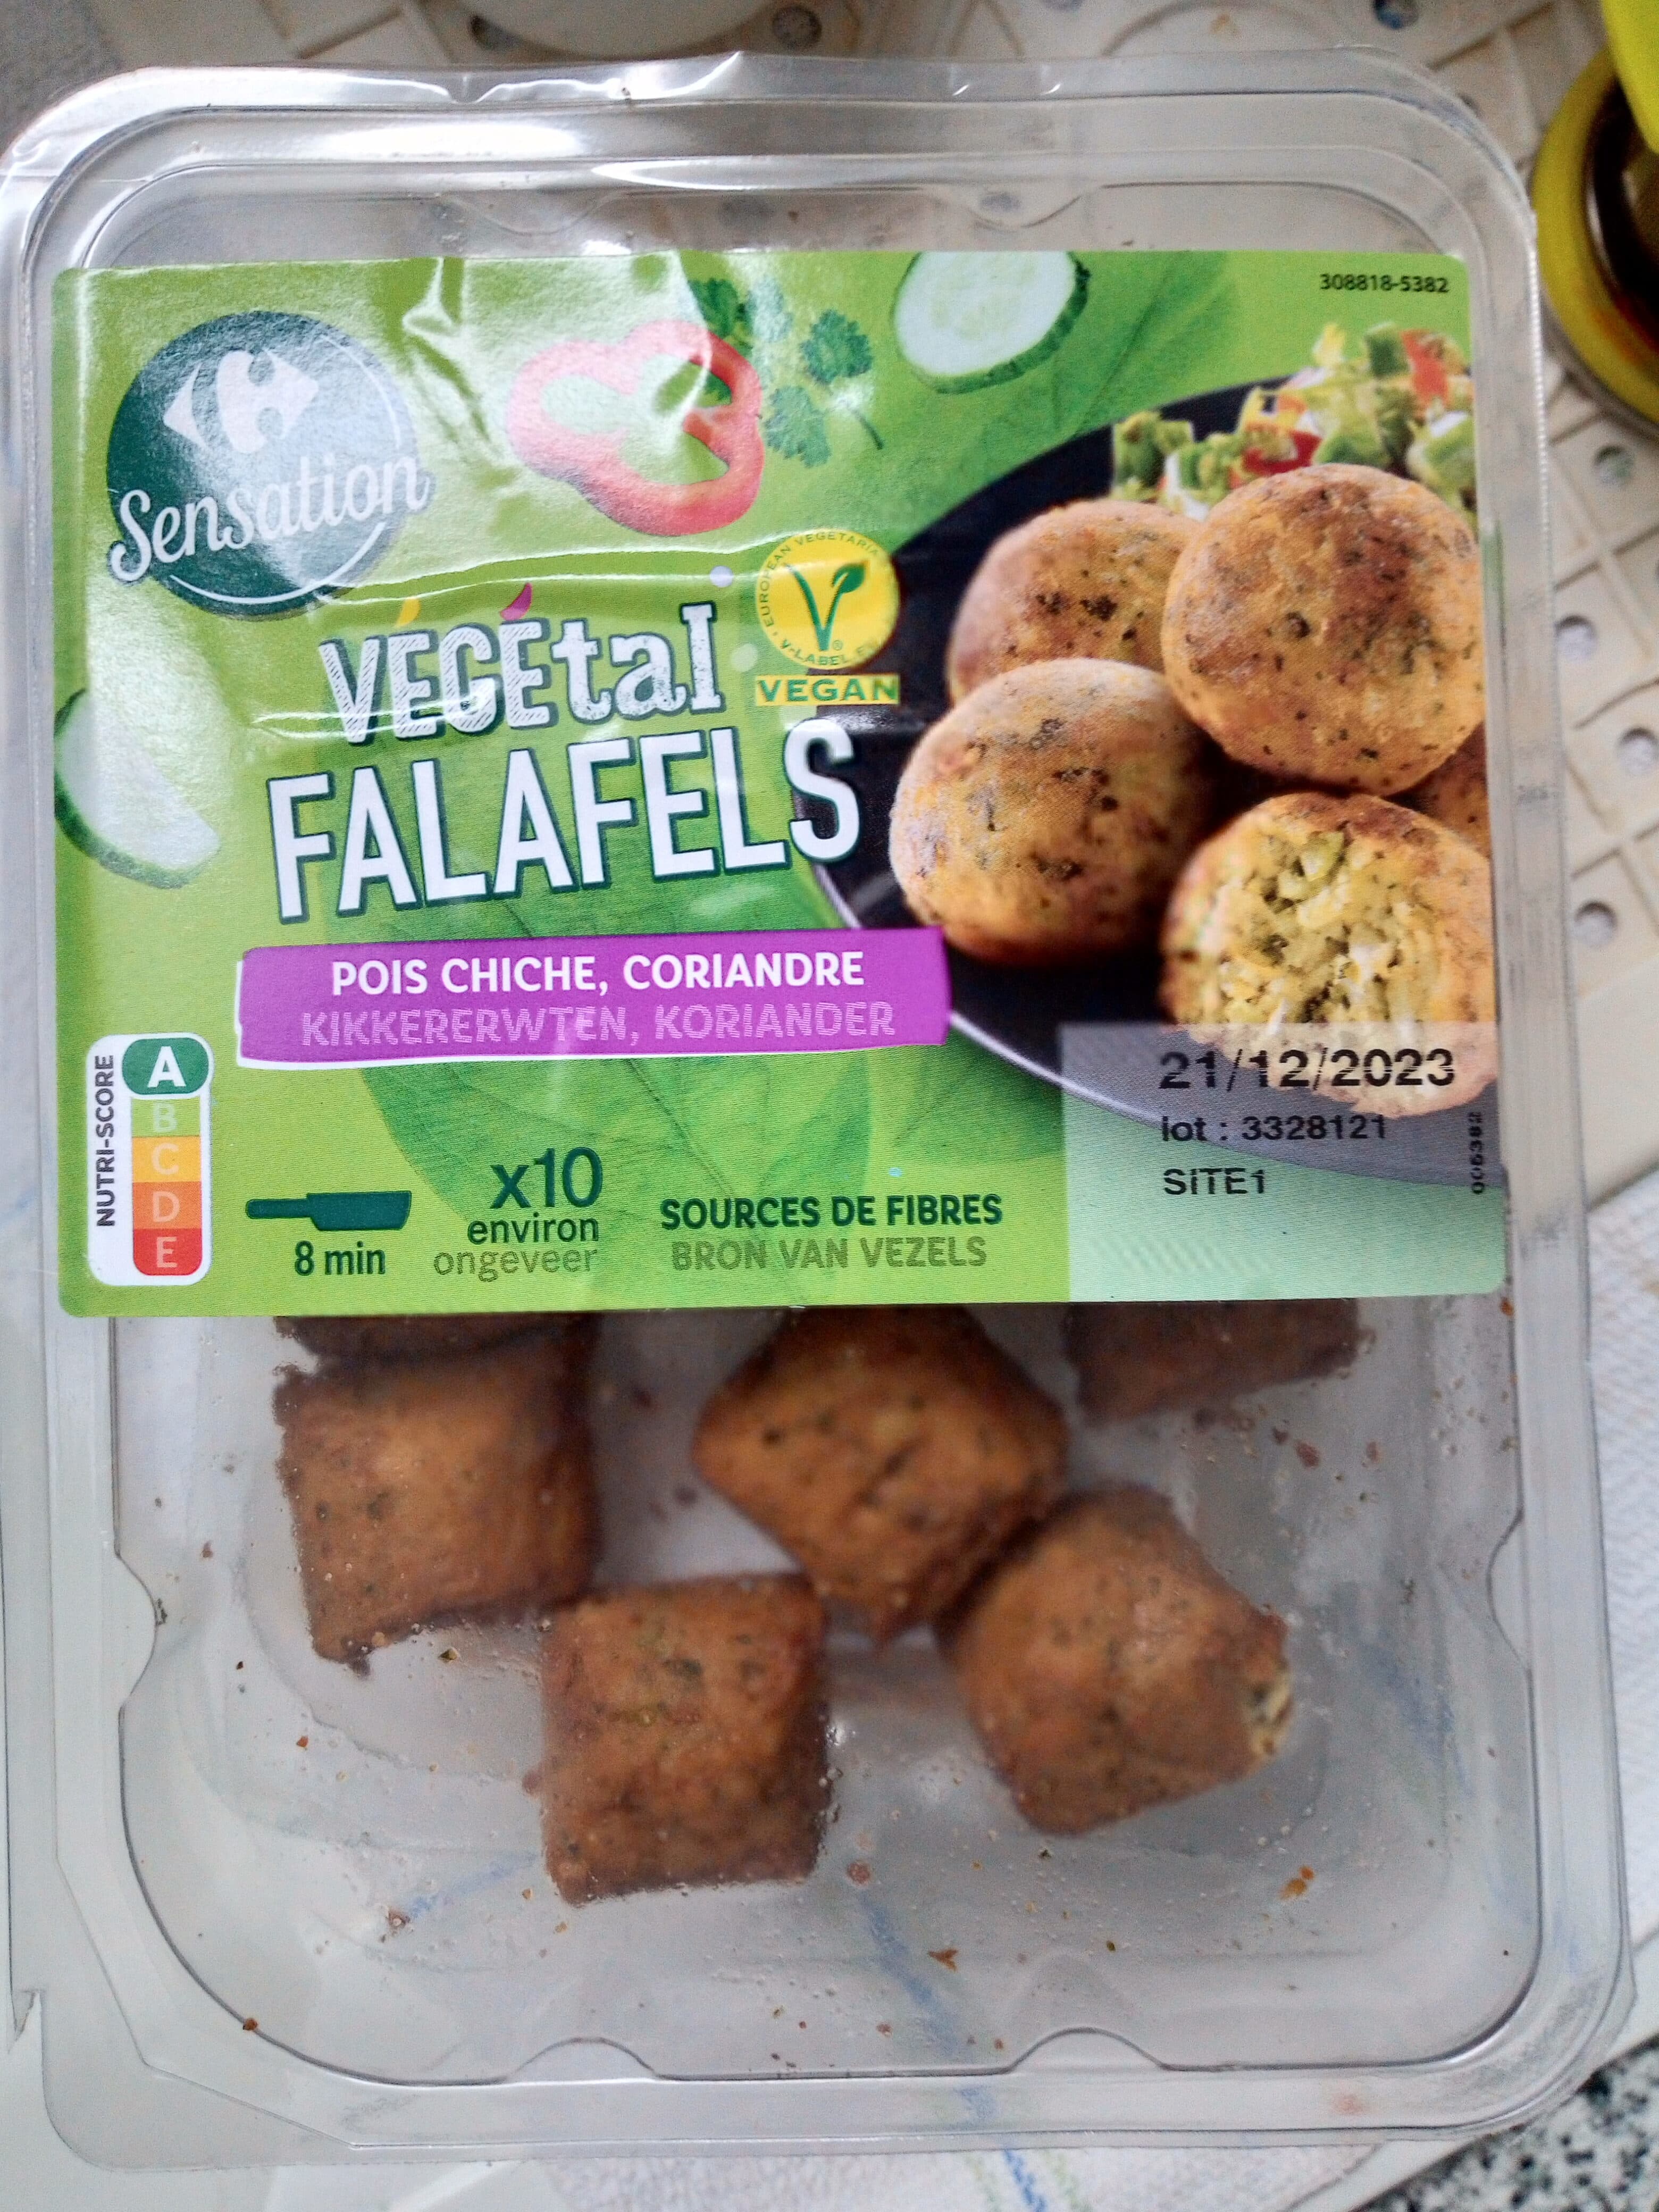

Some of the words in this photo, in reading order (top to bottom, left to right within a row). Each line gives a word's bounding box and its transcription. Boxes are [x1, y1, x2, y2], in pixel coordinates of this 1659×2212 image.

[1320, 273, 1450, 292] 308818-5382
[110, 454, 430, 582] Sensation
[759, 678, 899, 702] VEGAN
[267, 718, 860, 923] FALAFELS
[332, 959, 428, 995] POIS
[441, 954, 608, 994] CHICHE,
[623, 951, 865, 989] CORIANDRE
[301, 1005, 639, 1046] KIKKERERWTEN,
[655, 1001, 895, 1040] KORIANDER
[147, 1046, 186, 1088] A
[1159, 1047, 1455, 1091] 21/12/2023
[152, 1103, 177, 1132] B
[1242, 1115, 1387, 1141] 3328121
[95, 1055, 115, 1226] NUTRI-SCORE
[152, 1143, 179, 1175] C
[490, 1146, 603, 1210] x10
[1163, 1168, 1266, 1195] SITE1
[152, 1191, 180, 1222] D
[660, 1196, 820, 1230] SOURCES
[832, 1196, 875, 1226] DE
[887, 1194, 1002, 1225] FIBRES
[467, 1211, 600, 1245] environ
[156, 1236, 177, 1268] E
[295, 1241, 314, 1277] 8
[324, 1241, 386, 1275] min
[433, 1244, 598, 1283] ongeveer
[671, 1239, 768, 1271] BRON
[781, 1238, 850, 1269] VAN
[859, 1236, 987, 1268] VEZELS
